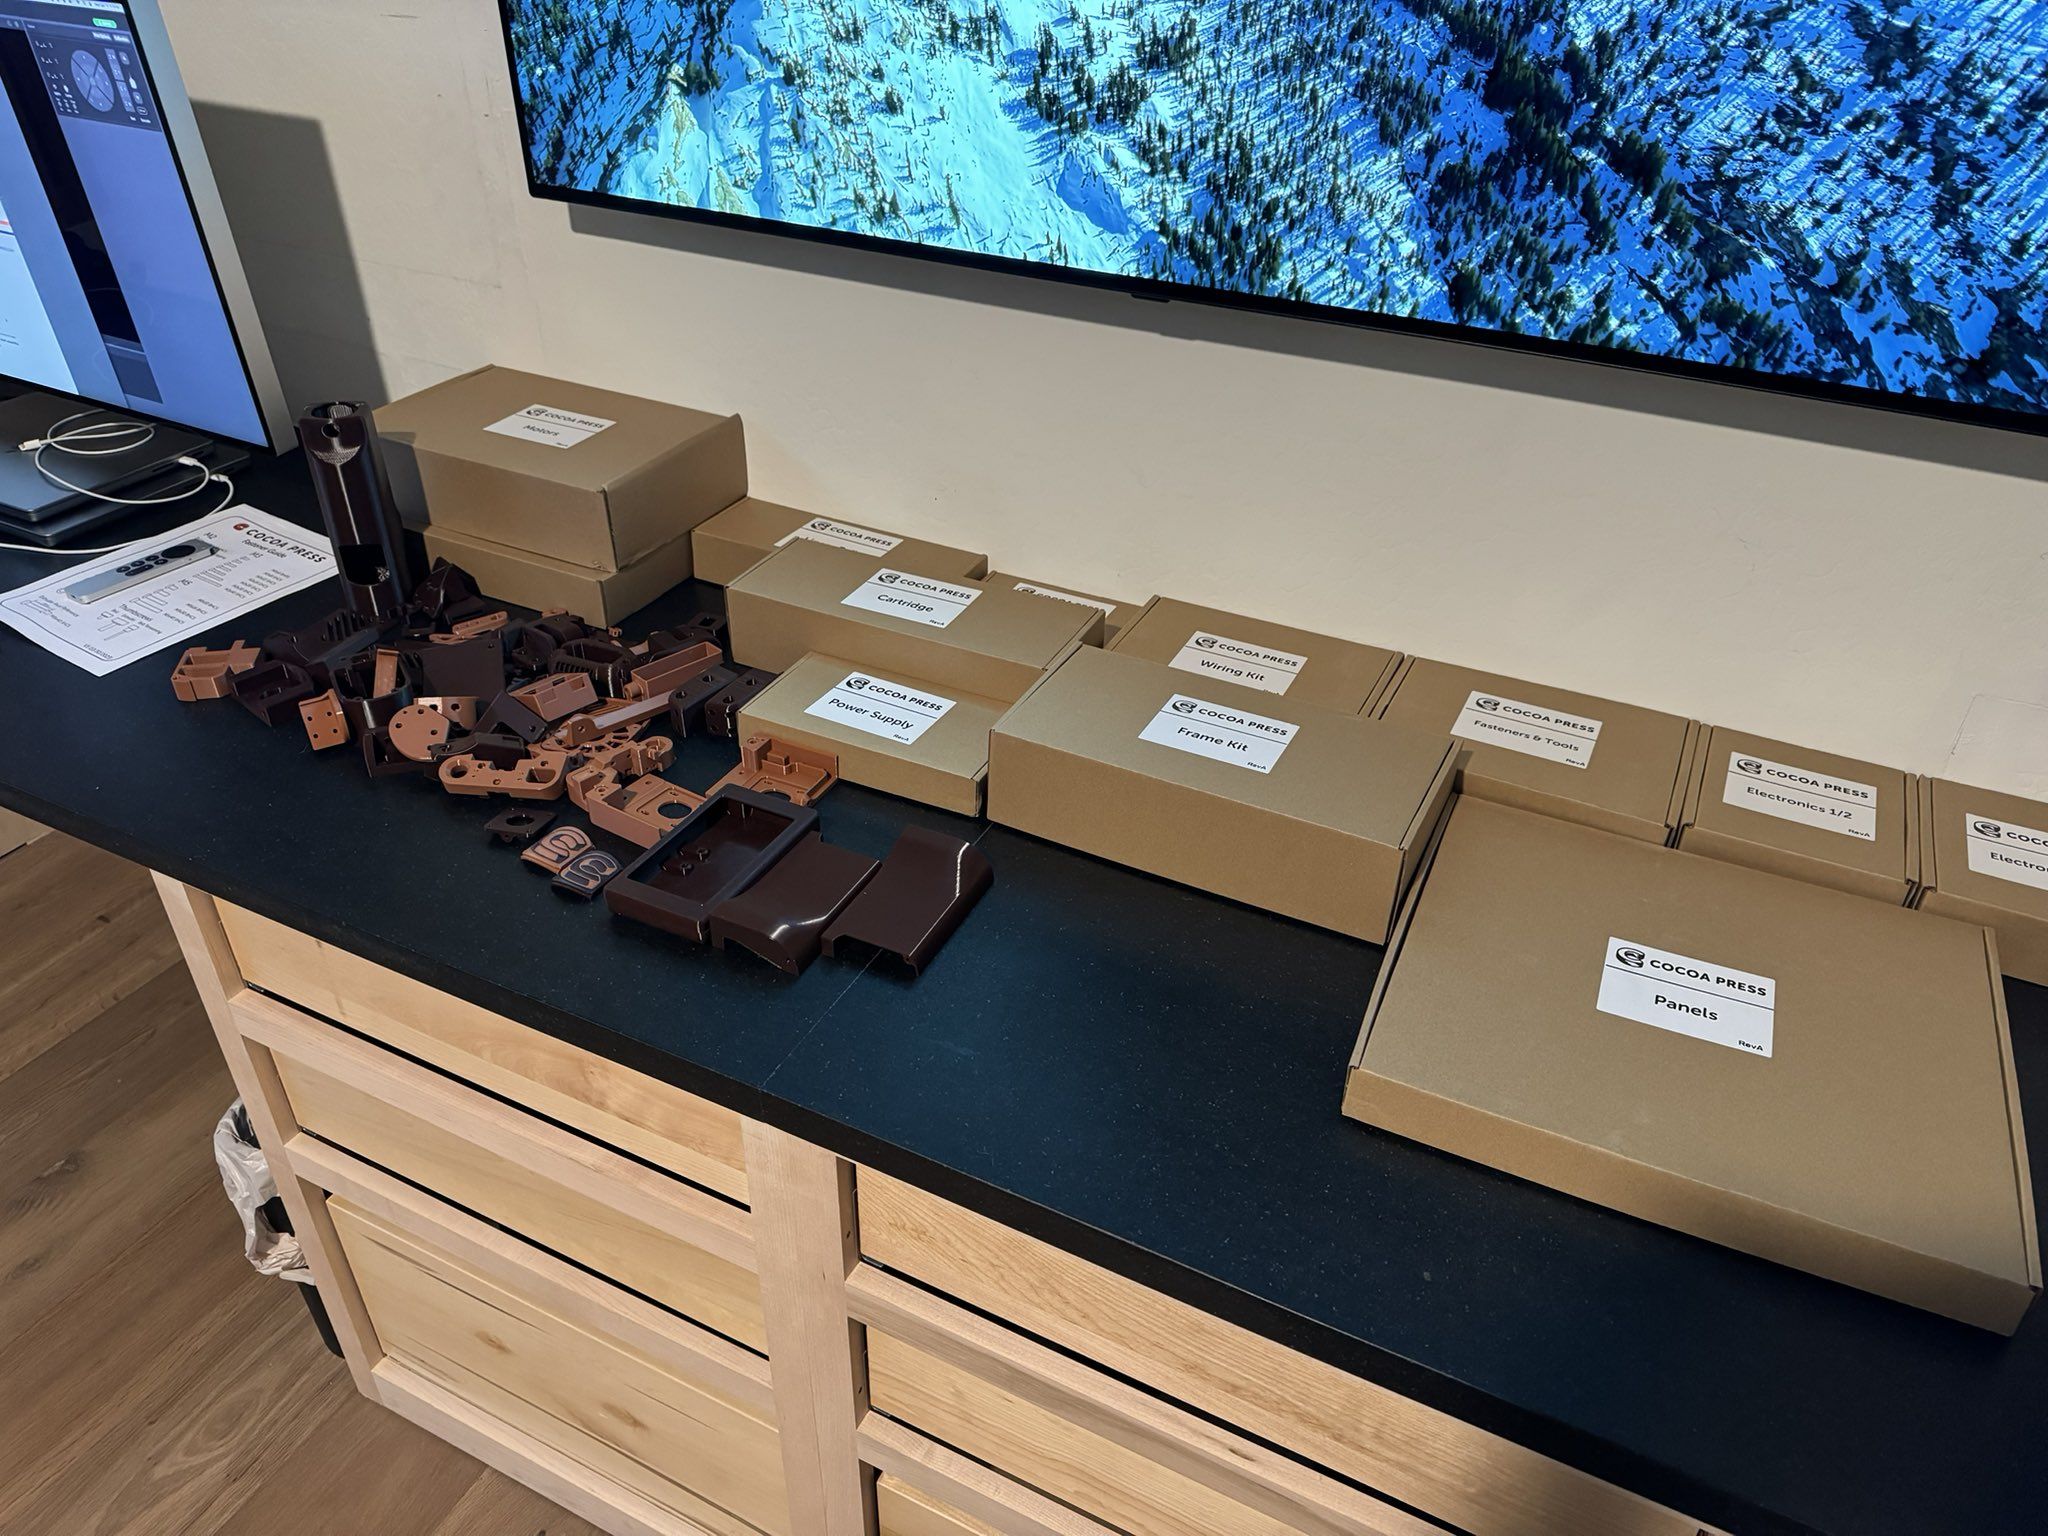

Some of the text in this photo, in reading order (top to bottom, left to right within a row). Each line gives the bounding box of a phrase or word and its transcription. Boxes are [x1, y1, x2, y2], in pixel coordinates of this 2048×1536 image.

[523, 424, 560, 436] Motors
[545, 411, 605, 429] COCOA PRESS
[246, 529, 326, 563] COCOA PRESS
[829, 526, 863, 540] COCOA
[864, 535, 893, 547] PRESS
[900, 578, 972, 600] COCOA PRESS
[877, 594, 934, 613] Cartridge
[1218, 643, 1298, 667] COCOA PRESS
[1201, 659, 1265, 682] Wiring Kit
[868, 684, 943, 711] COCOA PRESS
[828, 698, 914, 730] Power Supply
[1198, 708, 1288, 736] COCOA PRESS
[1502, 706, 1595, 733] COCOA PRESS
[1177, 727, 1249, 752] Frame Kit
[1474, 720, 1530, 739] Fasteners
[1545, 737, 1580, 752] Tools
[1766, 769, 1869, 799] COCOA PRESS
[1746, 786, 1853, 820] Electronics 1/2
[1990, 852, 2048, 872] Electro
[1650, 959, 1767, 996] COCOA PRESS
[1654, 994, 1719, 1021] Panels
[1738, 1039, 1764, 1051] RevA
